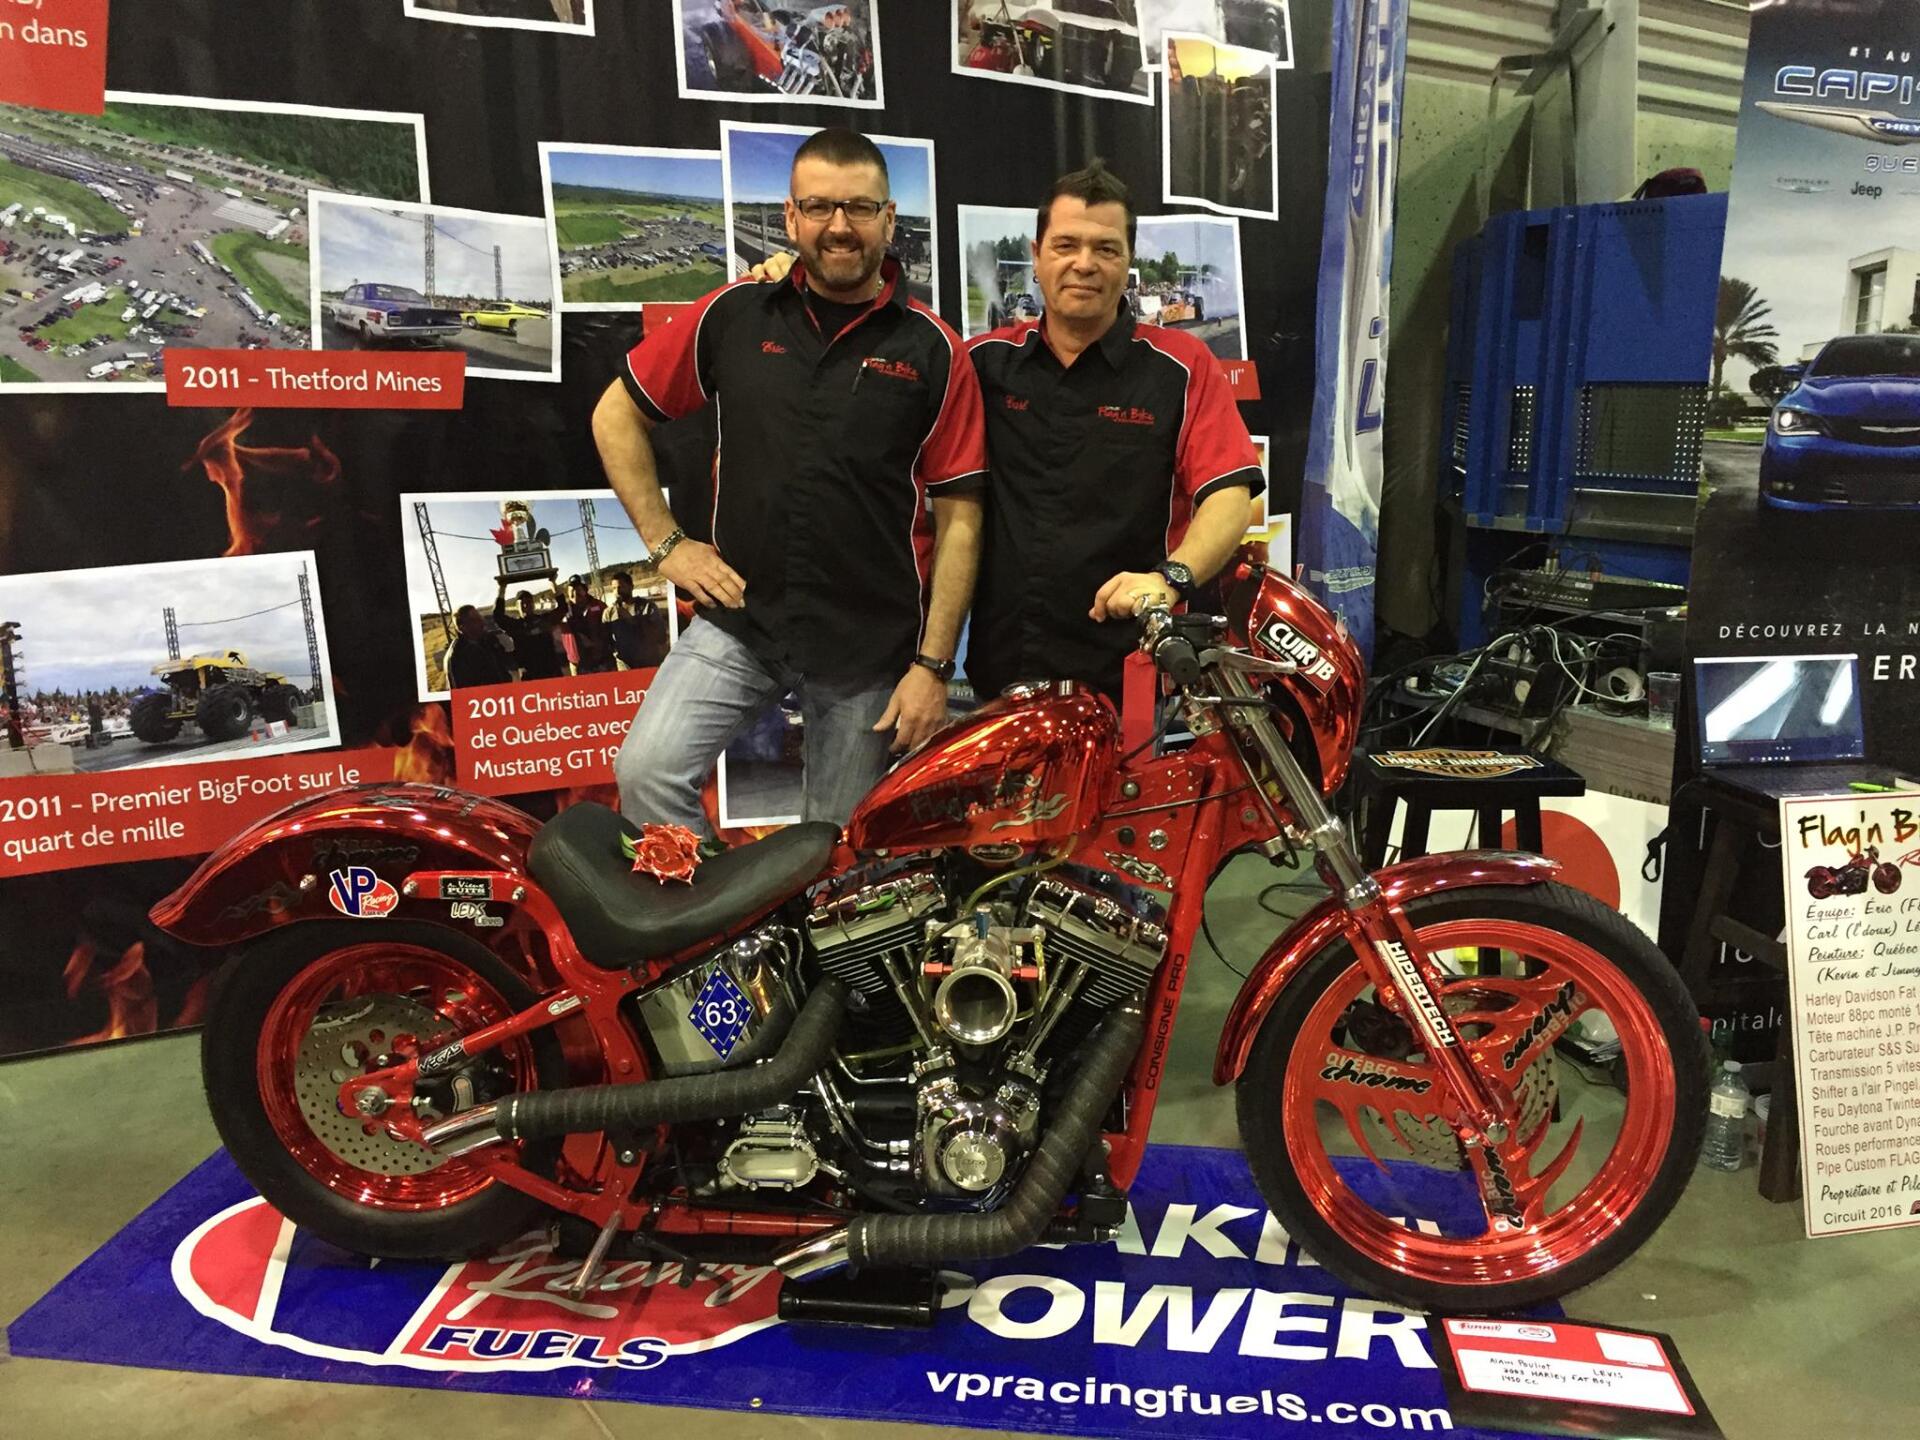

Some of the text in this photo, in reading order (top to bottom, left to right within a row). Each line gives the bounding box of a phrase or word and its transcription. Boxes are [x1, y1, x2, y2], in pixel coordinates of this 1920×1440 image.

[21, 17, 88, 48] dans
[1774, 64, 1920, 105] CAPI
[1851, 181, 1883, 200] Jeep
[182, 366, 240, 388] 2011
[265, 367, 369, 391] Thetford
[375, 370, 443, 392] Mines
[1719, 623, 1842, 638] DÉCOUVREZ
[1864, 623, 1887, 636] LA
[1269, 622, 1318, 666] CUIR
[1305, 656, 1336, 681] JB
[1873, 655, 1917, 681] ER
[468, 696, 515, 719] 2011
[521, 689, 608, 714] Christian
[471, 719, 631, 749] de Québec avec
[474, 756, 563, 780] Mustang
[567, 748, 595, 769] GT
[1387, 756, 1525, 766] HARLEY-DAVIDSON
[1, 795, 62, 822] 2011
[91, 785, 192, 814] Premier
[198, 772, 293, 804] BigFoot
[298, 771, 333, 789] sur
[339, 764, 361, 786] le
[4, 818, 185, 862] quart de mille
[1797, 809, 1884, 858] Flag'n
[329, 866, 377, 916] VP
[1806, 901, 1855, 922] Équipe:
[1865, 897, 1892, 915] Éric
[1807, 924, 1839, 940] Carl
[1808, 942, 1918, 963] Peinture: Québec
[1817, 967, 1860, 984] (Kevin
[1865, 966, 1879, 978] et
[1386, 941, 1456, 1044] HIPERTECH
[1806, 986, 1917, 1008] Harley Davidson Fat
[705, 999, 738, 1027] 63
[1145, 954, 1185, 1090] CONSIGNE PRO
[1807, 1011, 1845, 1025] Moteur
[1849, 1008, 1875, 1023] 88pc
[1879, 1004, 1912, 1019] monté
[1808, 1030, 1833, 1043] Tête
[1836, 1027, 1882, 1041] machine
[418, 1038, 464, 1074] VEGAS
[1809, 1047, 1875, 1063] Carburateur
[1879, 1041, 1902, 1056] S&S
[1319, 1058, 1433, 1095] chrome
[1811, 1064, 1882, 1081] Transmission
[1886, 1061, 1893, 1074] 5
[1811, 1085, 1848, 1101] Shifter
[1862, 1082, 1881, 1096] l'air
[1813, 1105, 1834, 1119] Feu
[1838, 1101, 1882, 1118] Daytona
[1814, 1122, 1859, 1138] Fourche
[1863, 1119, 1892, 1133] avant
[1816, 1143, 1851, 1156] Roues
[1816, 1161, 1841, 1177] Pipe
[1845, 1157, 1886, 1172] Custom
[1821, 1184, 1881, 1204] Propriétaire
[1886, 1180, 1898, 1194] et
[1823, 1204, 1901, 1225] Circuit 2016
[421, 1323, 672, 1370] FUELS
[1501, 1375, 1521, 1384] 1450
